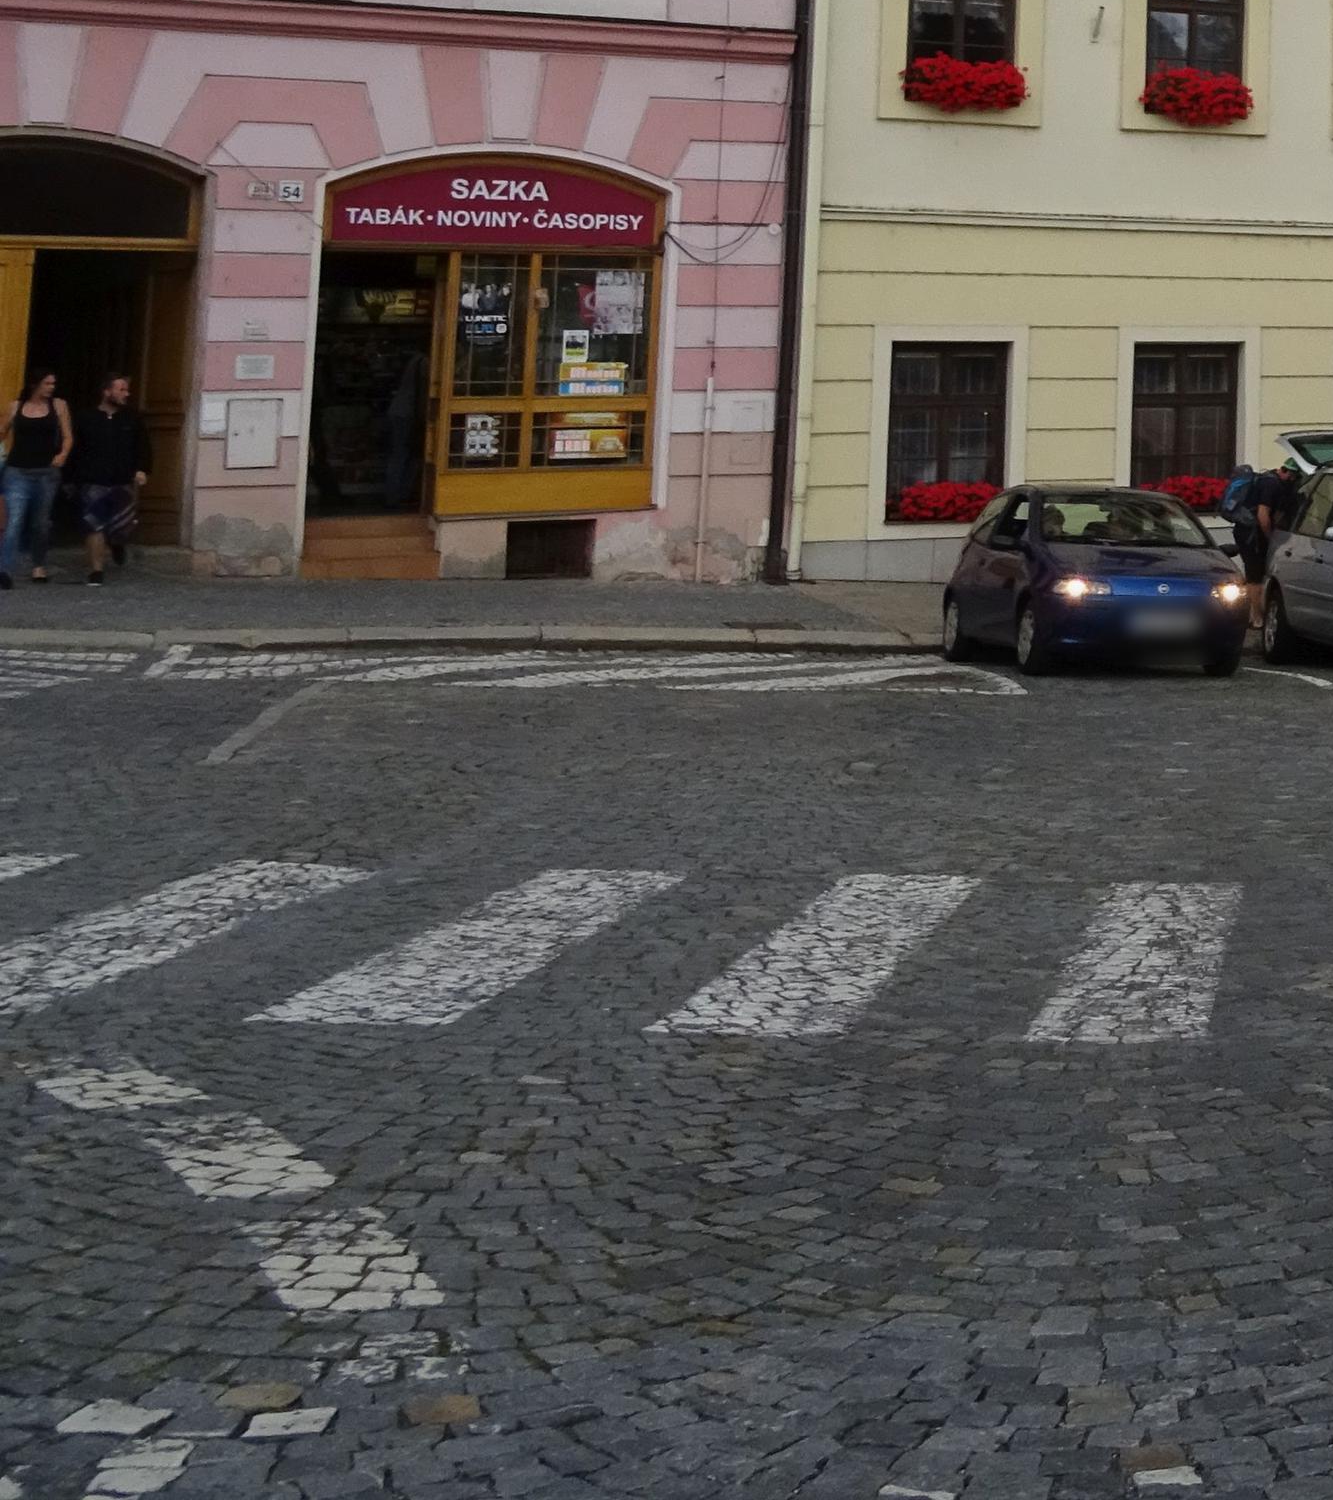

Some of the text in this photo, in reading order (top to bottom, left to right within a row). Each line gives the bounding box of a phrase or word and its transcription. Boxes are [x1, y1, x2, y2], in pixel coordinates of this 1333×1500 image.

[282, 186, 300, 199] 54
[450, 178, 549, 202] SAZKA
[345, 206, 643, 231] TABÁK NOVINY ČASOPISY
